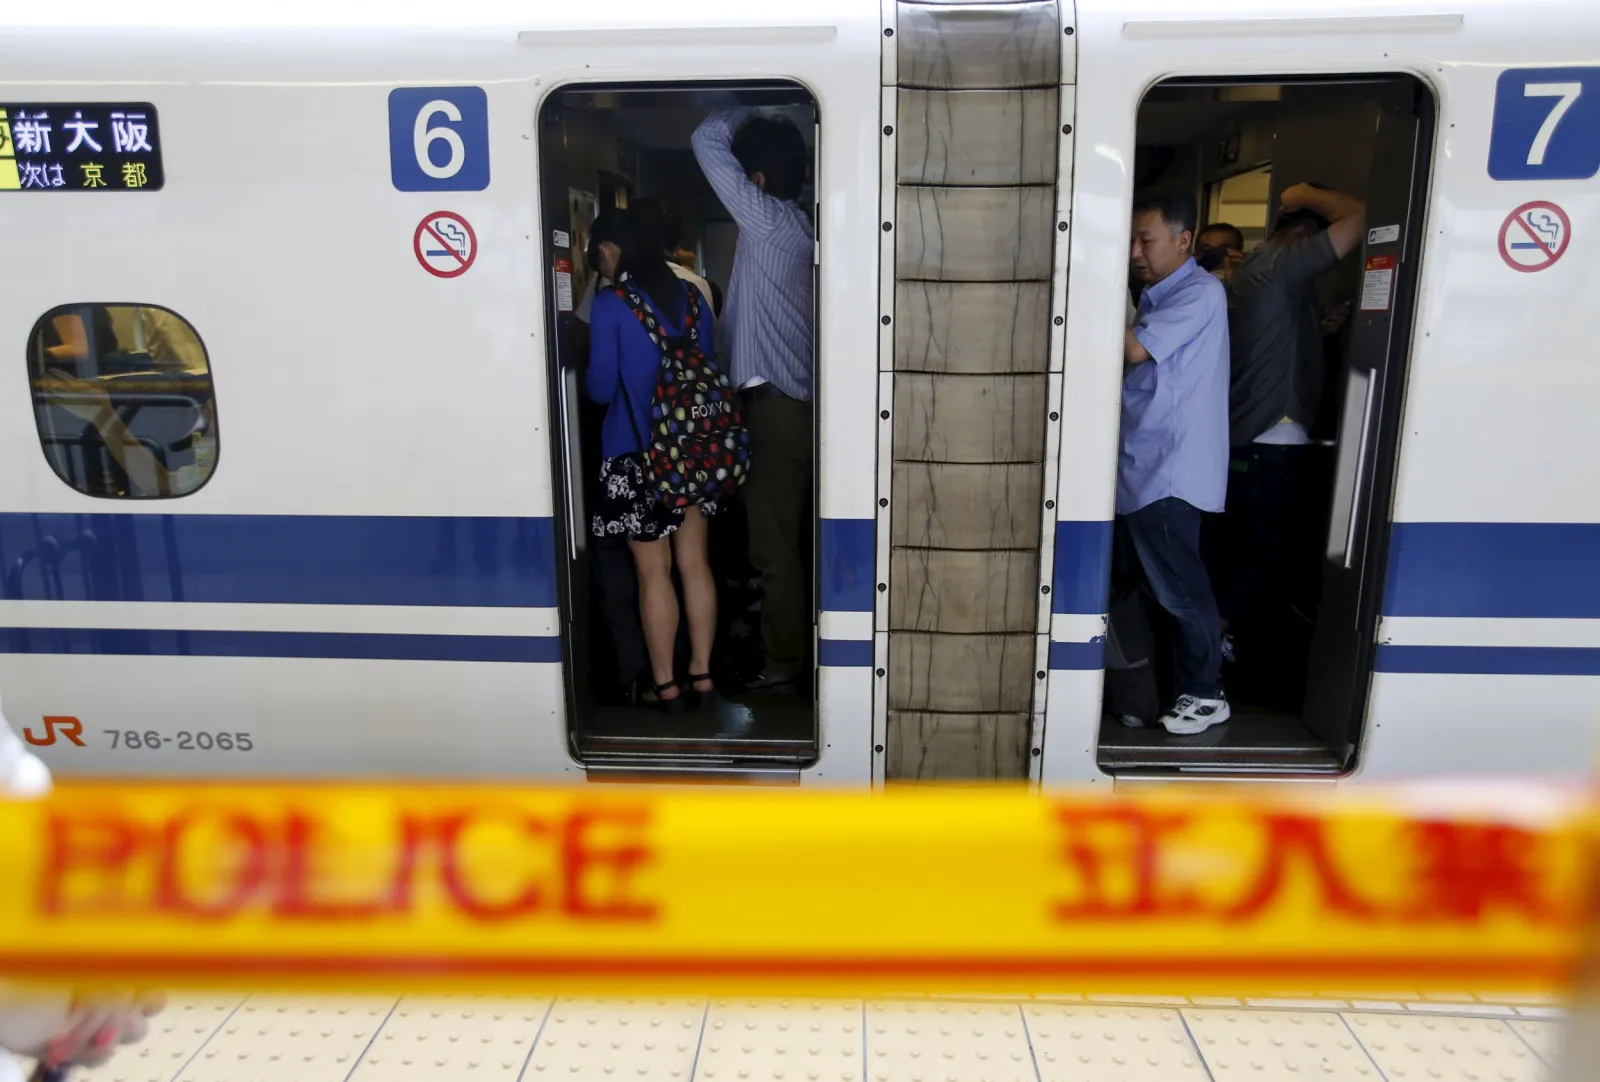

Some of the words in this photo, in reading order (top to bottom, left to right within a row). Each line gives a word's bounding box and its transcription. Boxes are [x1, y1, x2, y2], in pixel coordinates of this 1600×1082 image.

[13, 109, 153, 153] 新大阪
[413, 99, 465, 179] 6
[1523, 82, 1582, 165] 7
[18, 159, 66, 188] 次は
[79, 161, 148, 188] 京都
[691, 400, 723, 419] ROXY
[23, 715, 87, 747] JR
[103, 729, 254, 752] 786-2065
[36, 803, 662, 922] POLICE
